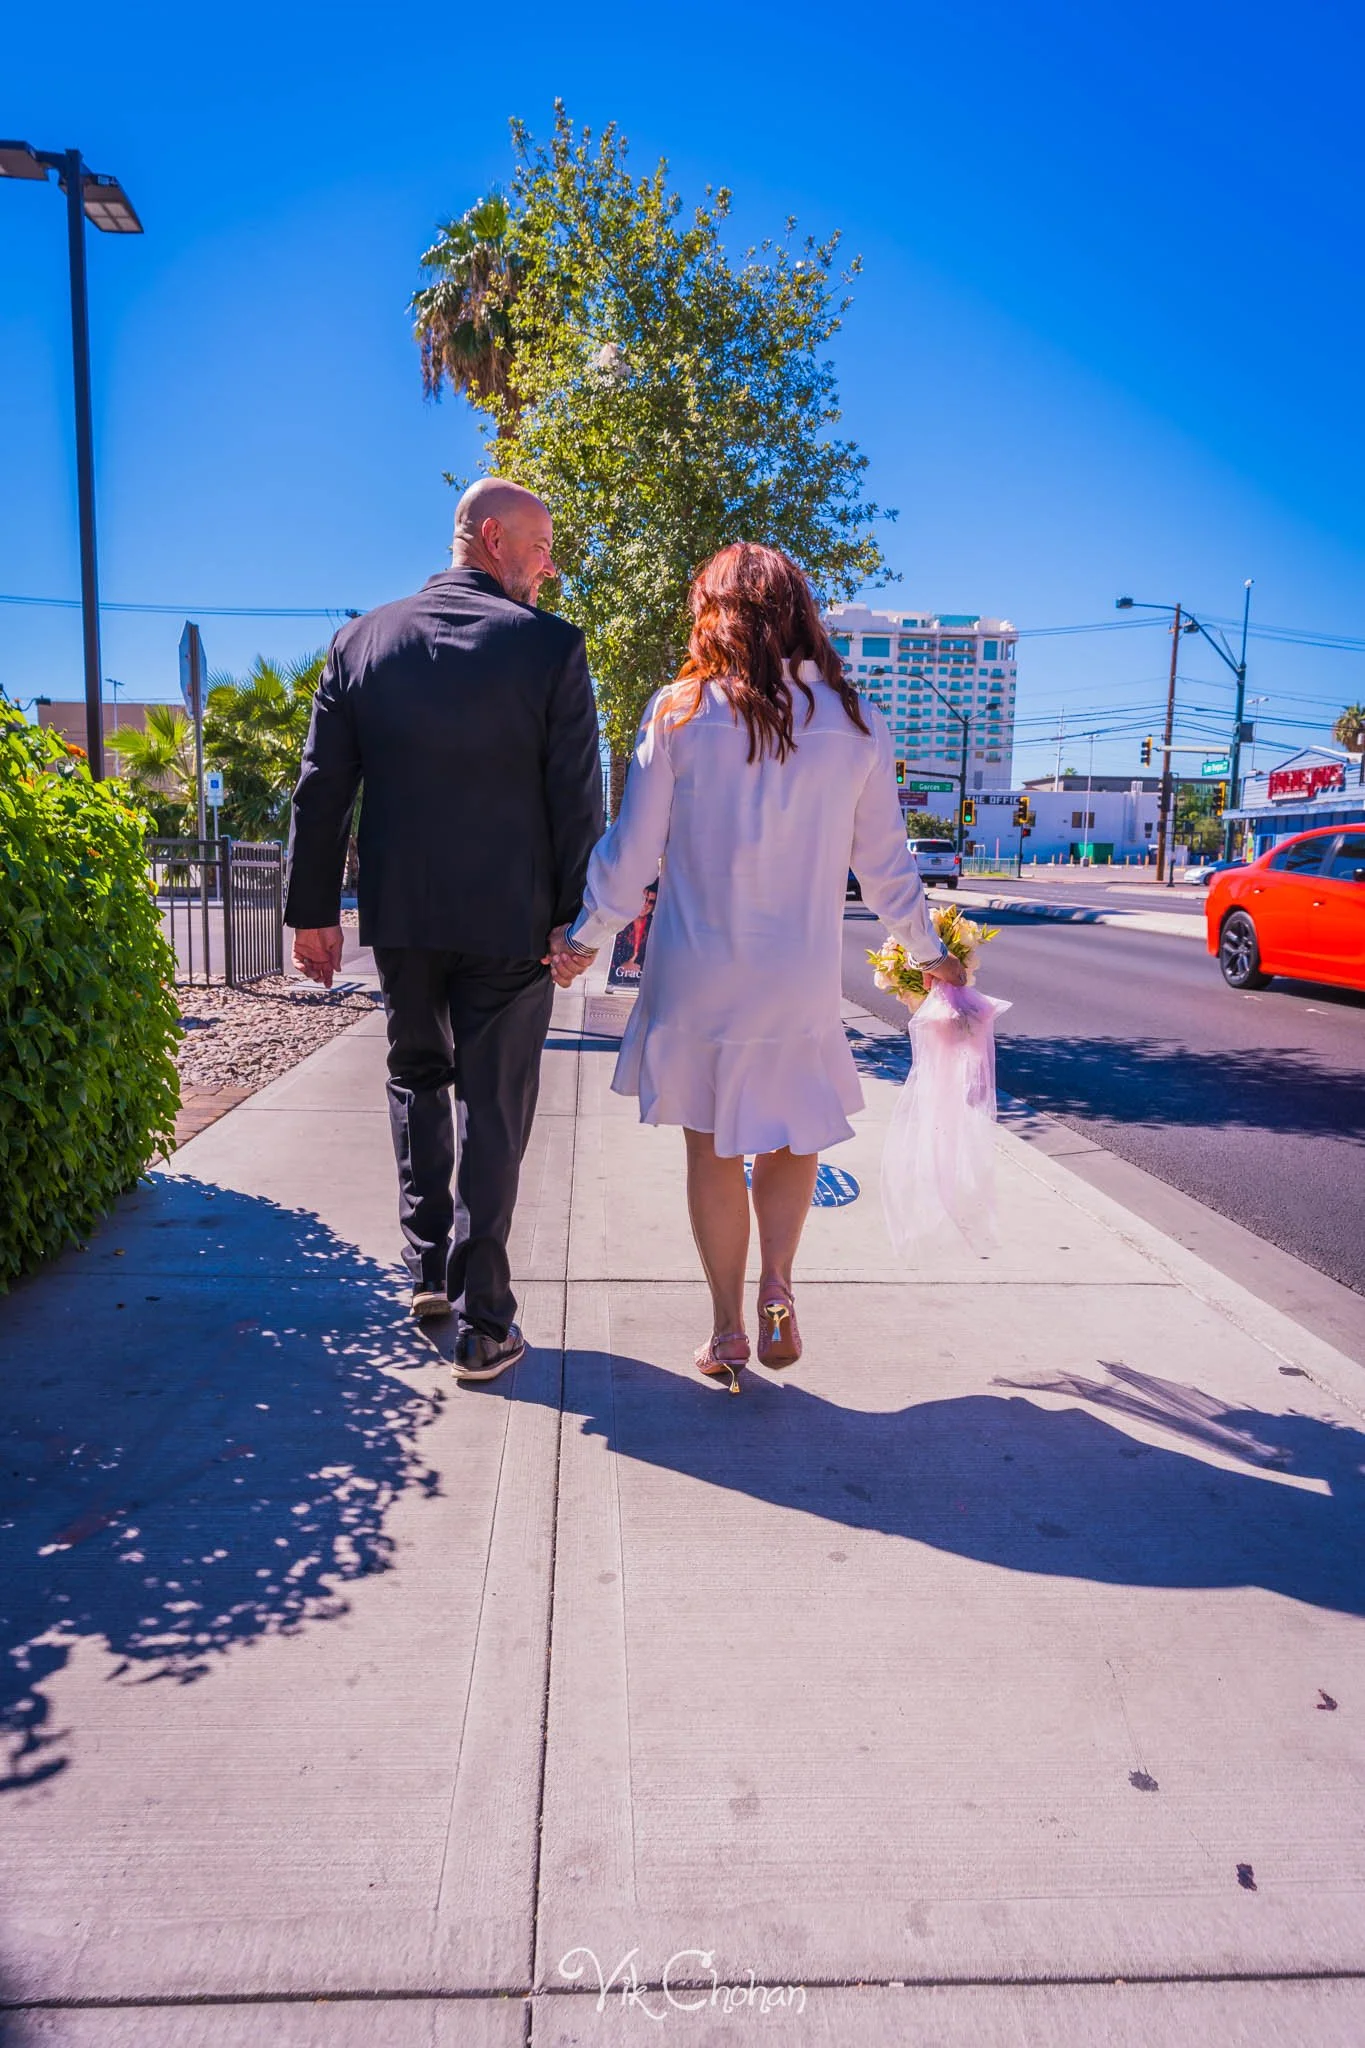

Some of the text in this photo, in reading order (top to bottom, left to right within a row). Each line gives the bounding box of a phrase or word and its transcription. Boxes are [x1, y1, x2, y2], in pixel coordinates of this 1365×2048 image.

[919, 783, 940, 791] Garces
[966, 795, 1020, 805] THE OFFIC
[615, 966, 642, 979] Grac
